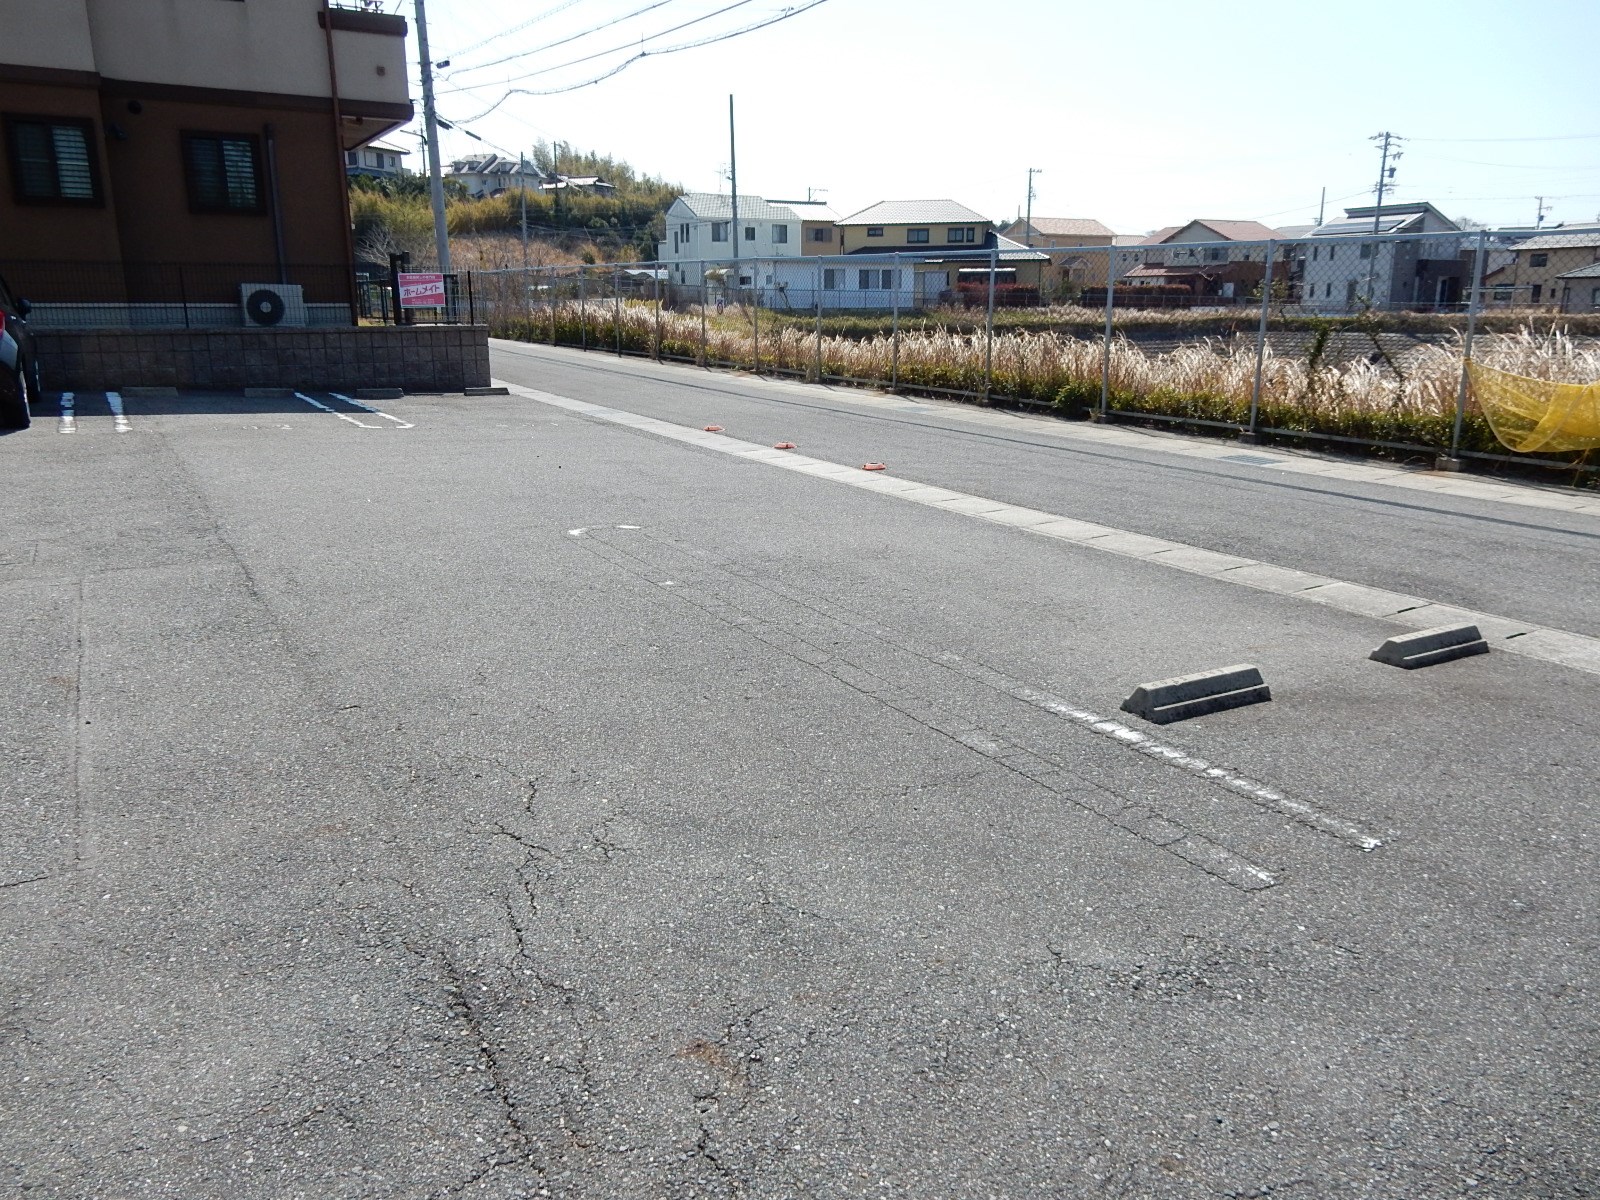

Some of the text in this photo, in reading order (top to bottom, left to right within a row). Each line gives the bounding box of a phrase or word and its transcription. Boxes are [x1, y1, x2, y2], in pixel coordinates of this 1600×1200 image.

[404, 284, 440, 296] ホームメイト
